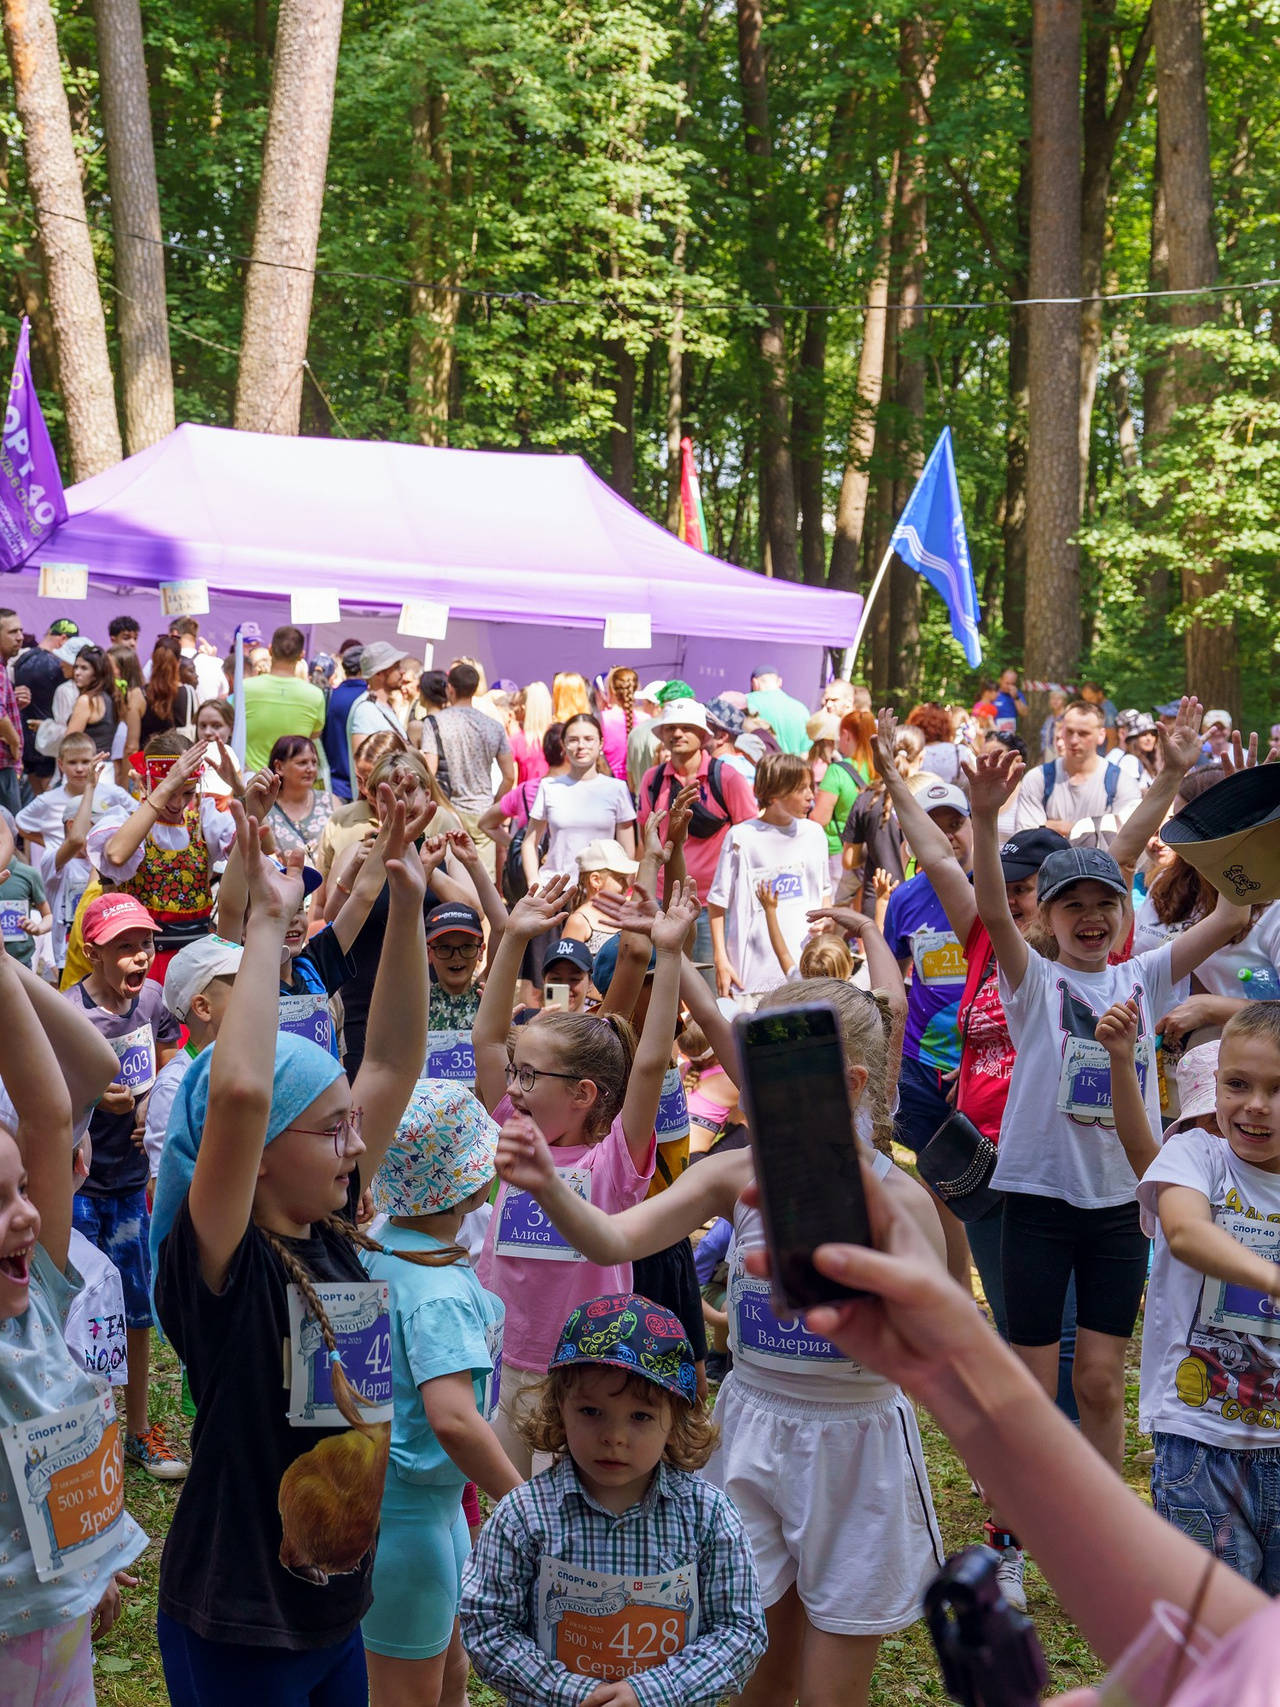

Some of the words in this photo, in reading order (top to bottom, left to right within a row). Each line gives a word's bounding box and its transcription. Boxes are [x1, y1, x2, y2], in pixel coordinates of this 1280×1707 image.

[775, 876, 800, 895] 672
[102, 901, 138, 920] Exact
[556, 941, 574, 954] LA
[122, 1049, 150, 1077] 603
[450, 1051, 476, 1069] 35
[440, 1068, 477, 1078] Михаил
[1080, 1075, 1098, 1088] 1К
[511, 1226, 551, 1241] Алиса
[1232, 1225, 1261, 1237] СПОРТ
[1263, 1228, 1275, 1238] 40
[343, 1293, 356, 1302] 40
[744, 1303, 762, 1322] 1К
[757, 1329, 832, 1356] Валерия
[365, 1332, 392, 1375] 42
[350, 1378, 390, 1403] Марта
[28, 1425, 63, 1442] СПОРТ
[64, 1419, 78, 1430] 40
[38, 1433, 100, 1482] Лукоморье
[57, 1488, 85, 1512] 500
[87, 1485, 98, 1500] м
[558, 1571, 585, 1586] СПОРТ
[586, 1580, 598, 1589] 40
[554, 1600, 618, 1617] Лукоморье
[588, 1624, 604, 1633] 2025
[564, 1629, 587, 1648] 500
[591, 1641, 603, 1651] м
[608, 1618, 680, 1659] 428
